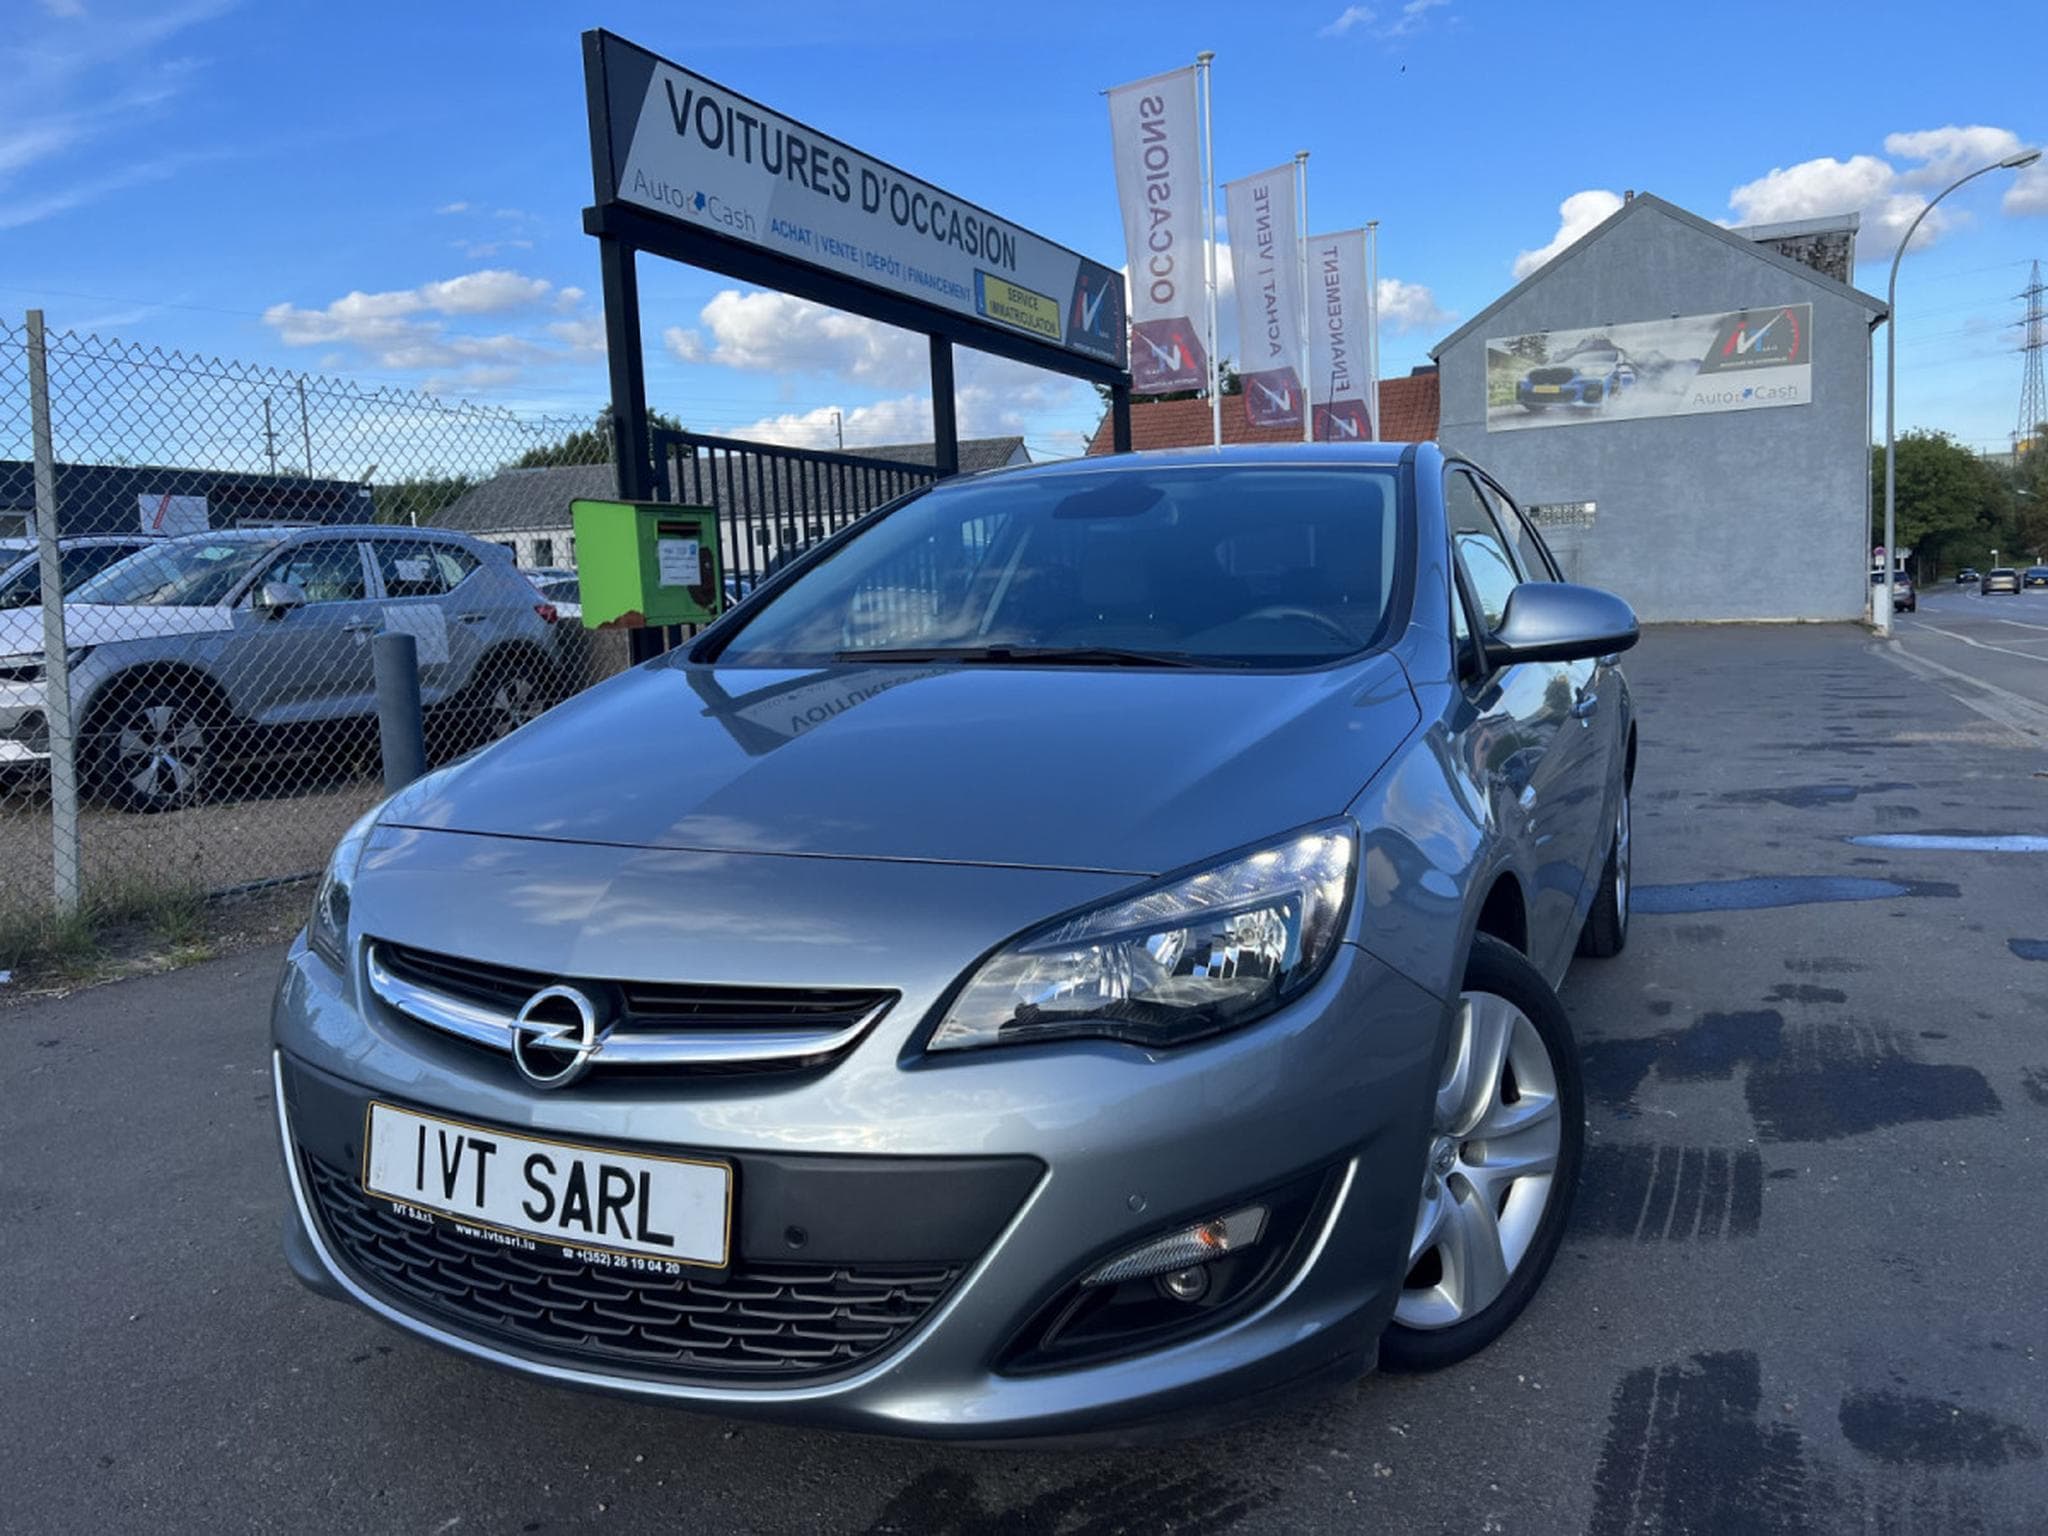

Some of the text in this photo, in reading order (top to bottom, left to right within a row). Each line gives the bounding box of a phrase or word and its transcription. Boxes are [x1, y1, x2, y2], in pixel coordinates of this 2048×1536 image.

[633, 168, 756, 234] Auto Cash
[664, 79, 1016, 271] VOITURES D'OCCASION
[771, 217, 813, 245] ACHAT
[821, 237, 859, 263] VENTE
[907, 266, 971, 301] FINANCEMENT
[416, 1124, 675, 1247] IVT SARL
[455, 1223, 536, 1251] www.ivtsarl.lu
[576, 1249, 611, 1267] +(352)
[631, 1257, 645, 1270] 19
[647, 1260, 662, 1273] 04
[665, 1262, 680, 1275] 20
